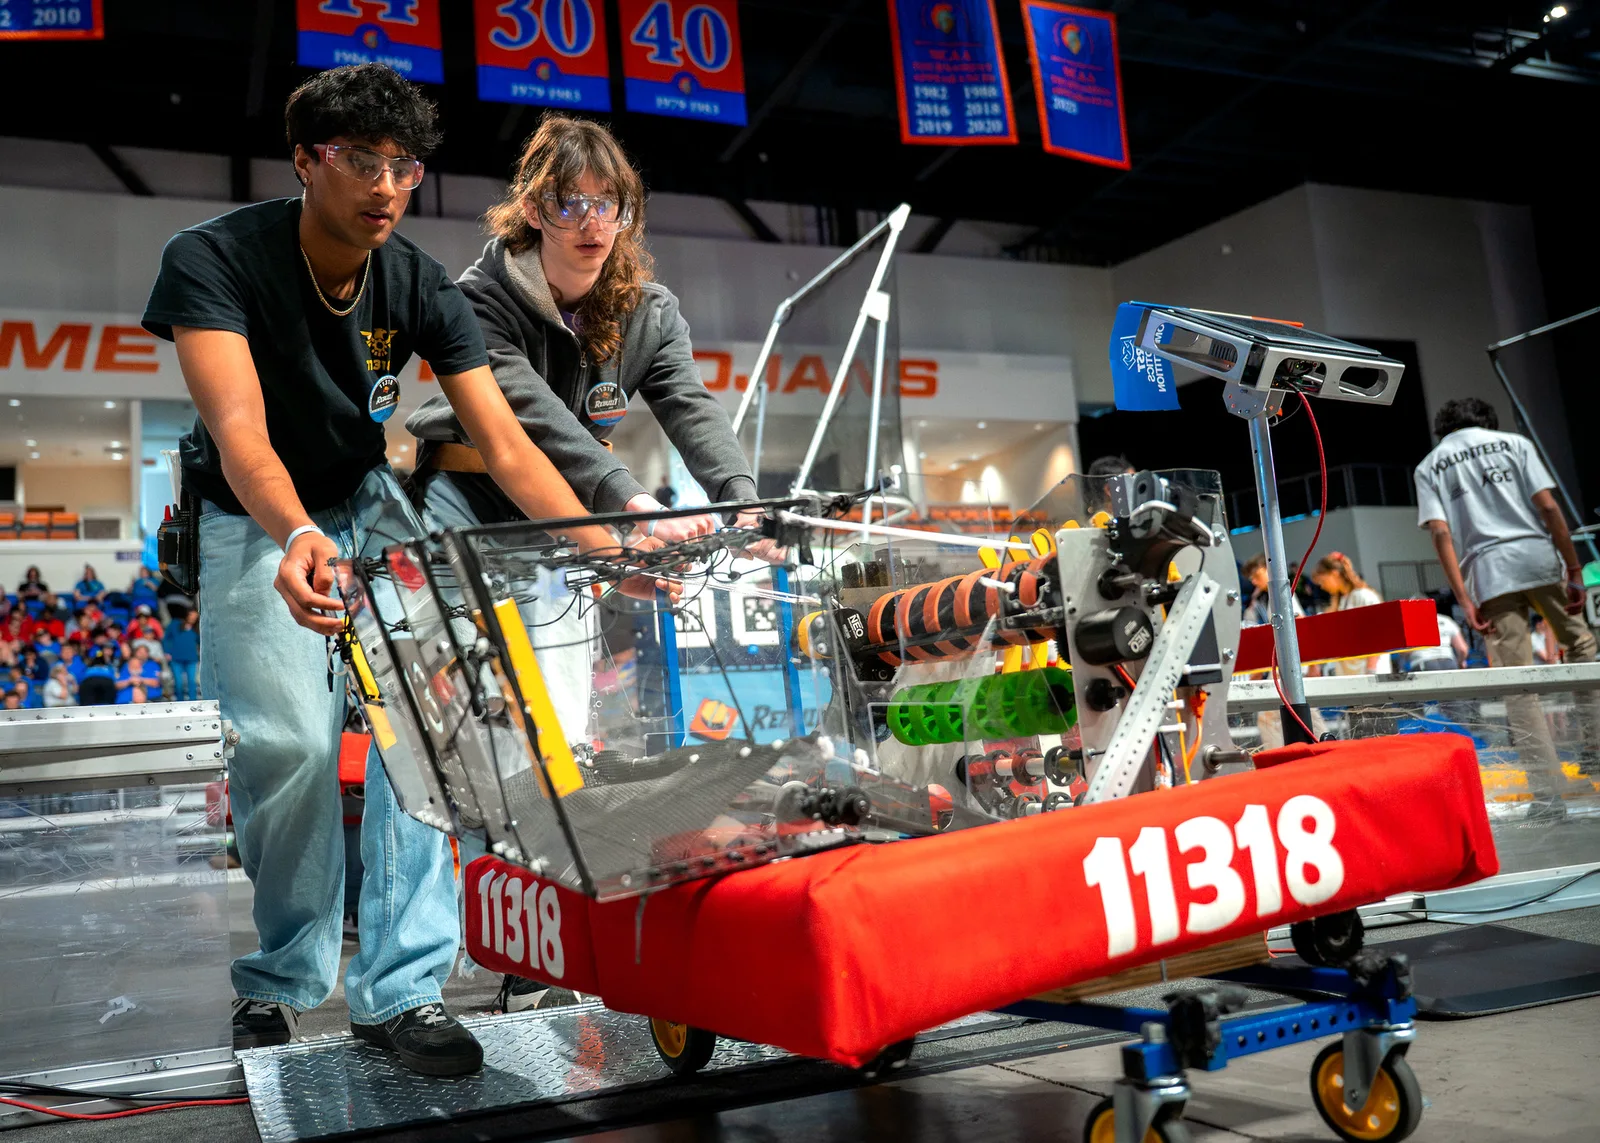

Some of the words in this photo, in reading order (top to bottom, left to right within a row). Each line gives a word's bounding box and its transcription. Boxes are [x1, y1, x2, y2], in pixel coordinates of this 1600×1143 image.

[33, 7, 81, 26] 2010
[488, 0, 595, 57] 30
[630, 0, 732, 72] 40
[915, 101, 951, 117] 2016
[965, 101, 1001, 117] 2018
[966, 118, 1003, 134] 2020
[693, 350, 939, 397] OJANS
[1430, 440, 1511, 475] VOLUNTEER
[1482, 470, 1513, 487] AGE
[848, 614, 864, 638] NEO
[1130, 626, 1151, 653] NEO
[1083, 795, 1344, 960] 11318
[478, 868, 565, 980] 11318
